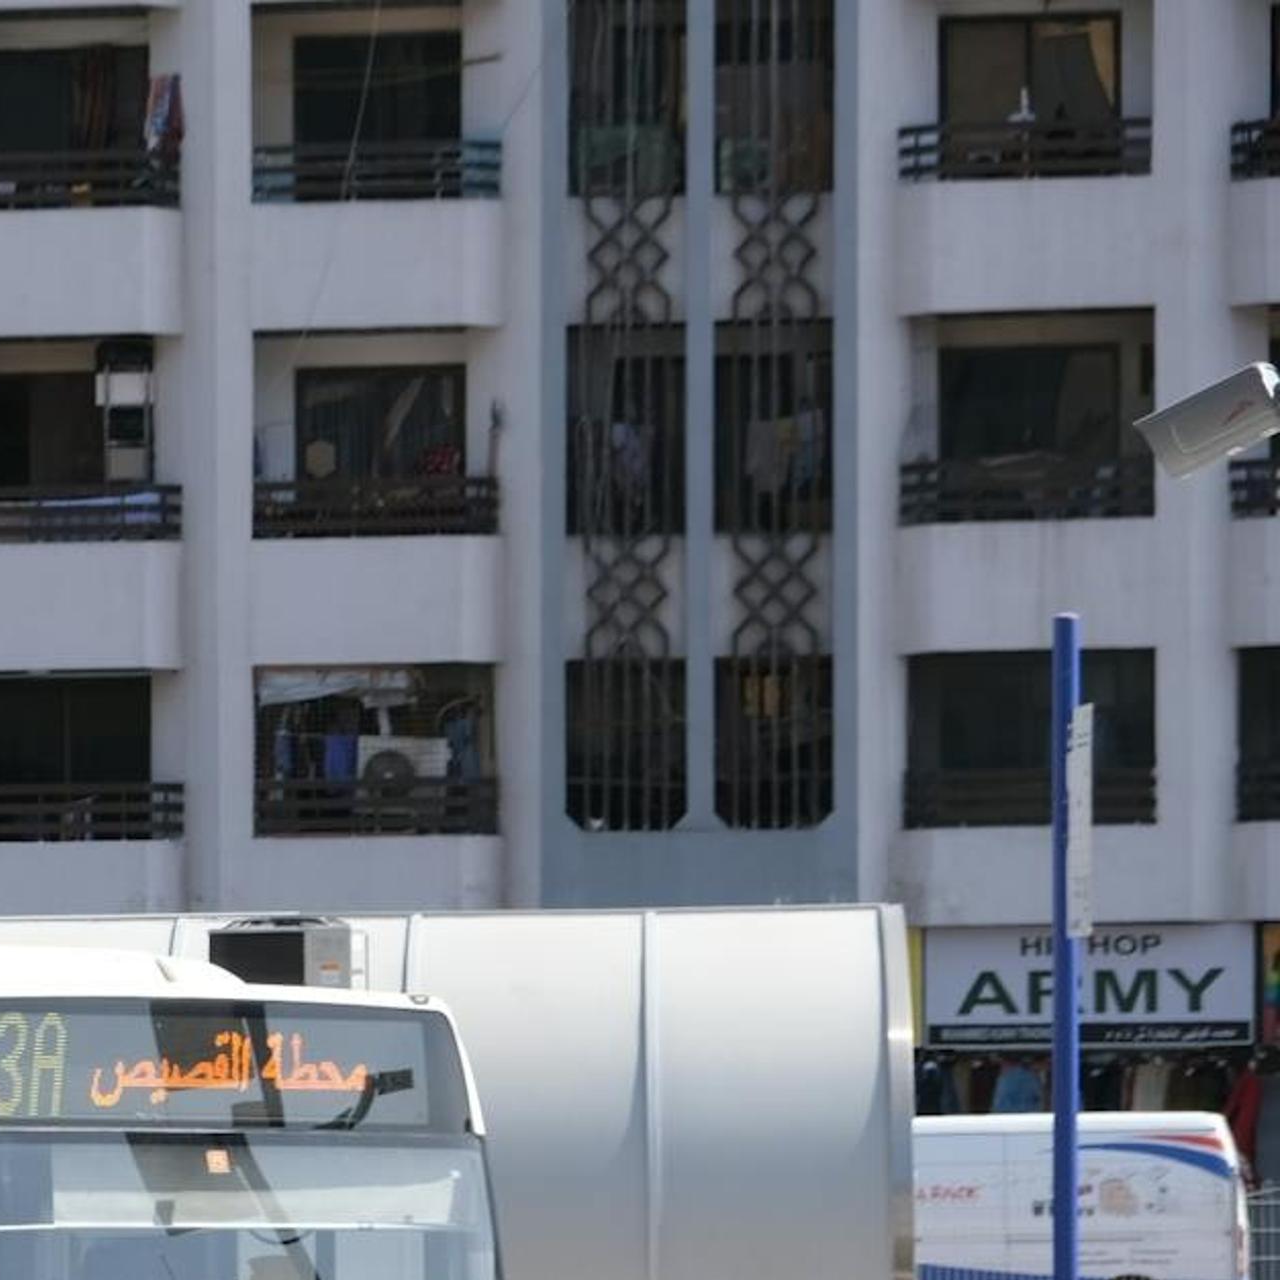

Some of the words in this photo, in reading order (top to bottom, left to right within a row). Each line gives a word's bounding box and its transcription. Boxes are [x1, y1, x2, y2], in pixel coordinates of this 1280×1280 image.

[1088, 935, 1160, 955] HOP
[90, 1030, 253, 1108] القصيص
[262, 1031, 368, 1091] محطة
